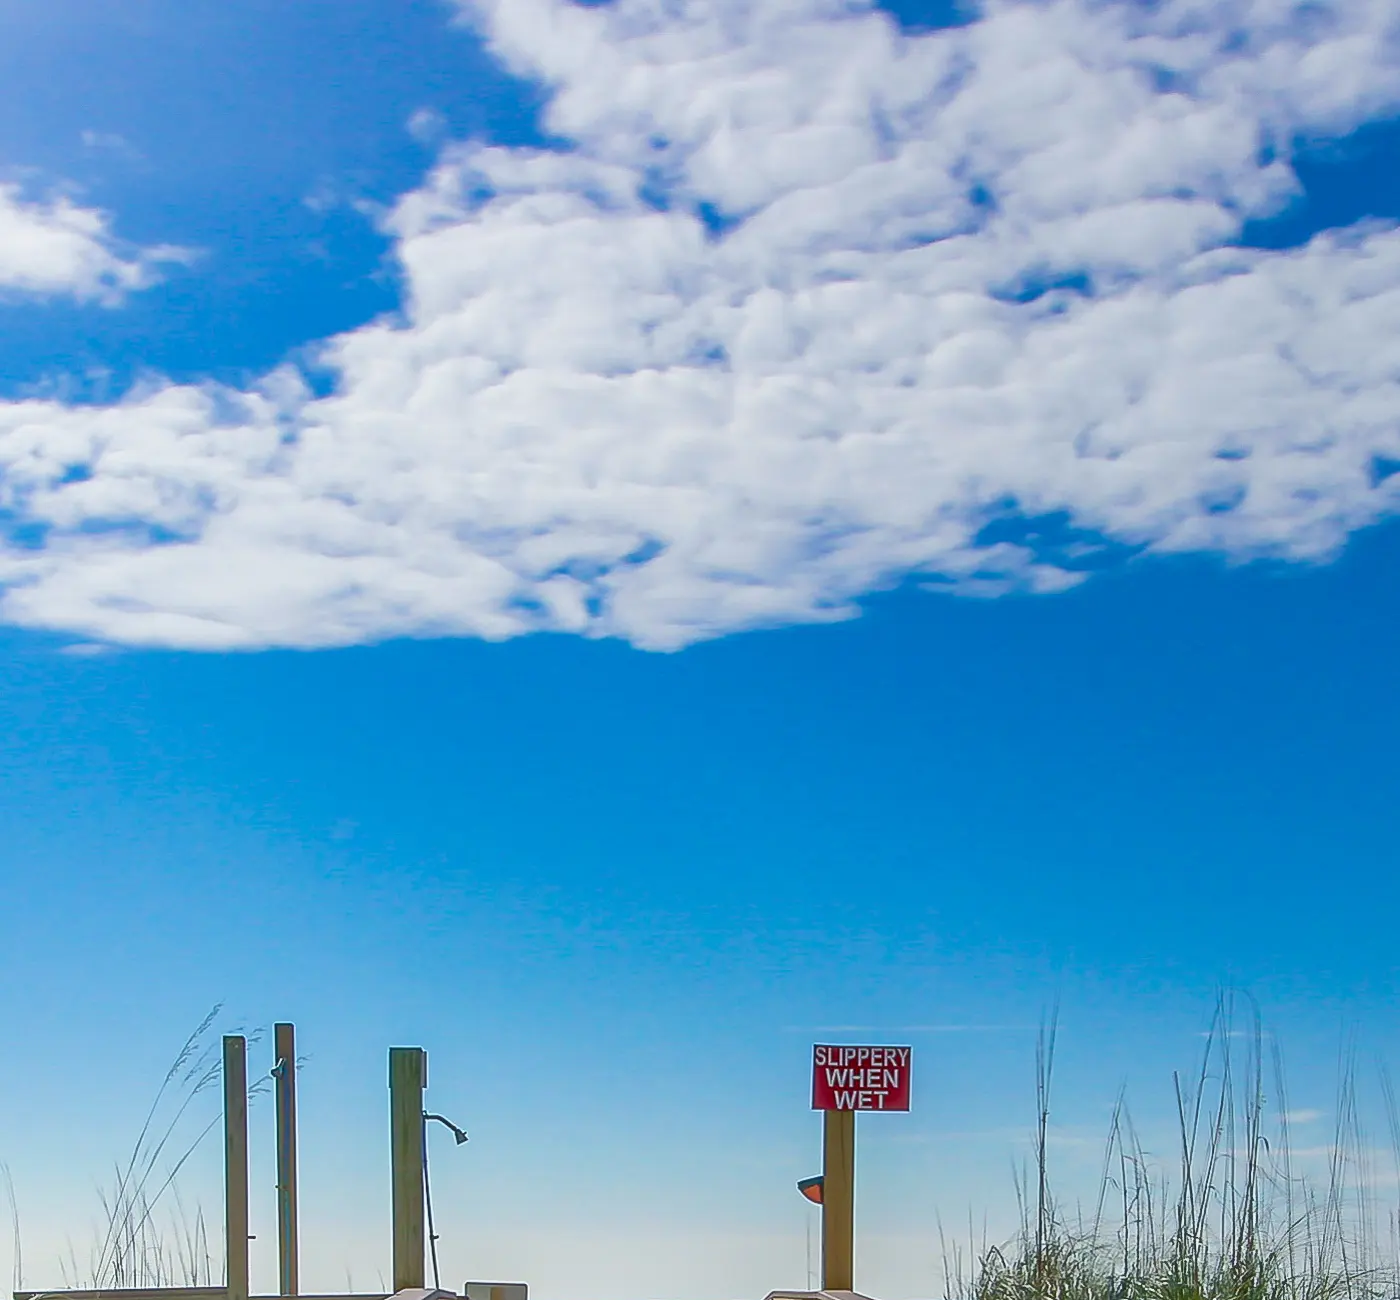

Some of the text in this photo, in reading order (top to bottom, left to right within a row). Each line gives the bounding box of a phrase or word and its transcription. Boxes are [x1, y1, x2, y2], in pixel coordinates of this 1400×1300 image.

[815, 1047, 909, 1067] SLIPPERY
[825, 1068, 899, 1088] WHEN
[833, 1090, 889, 1110] WET
